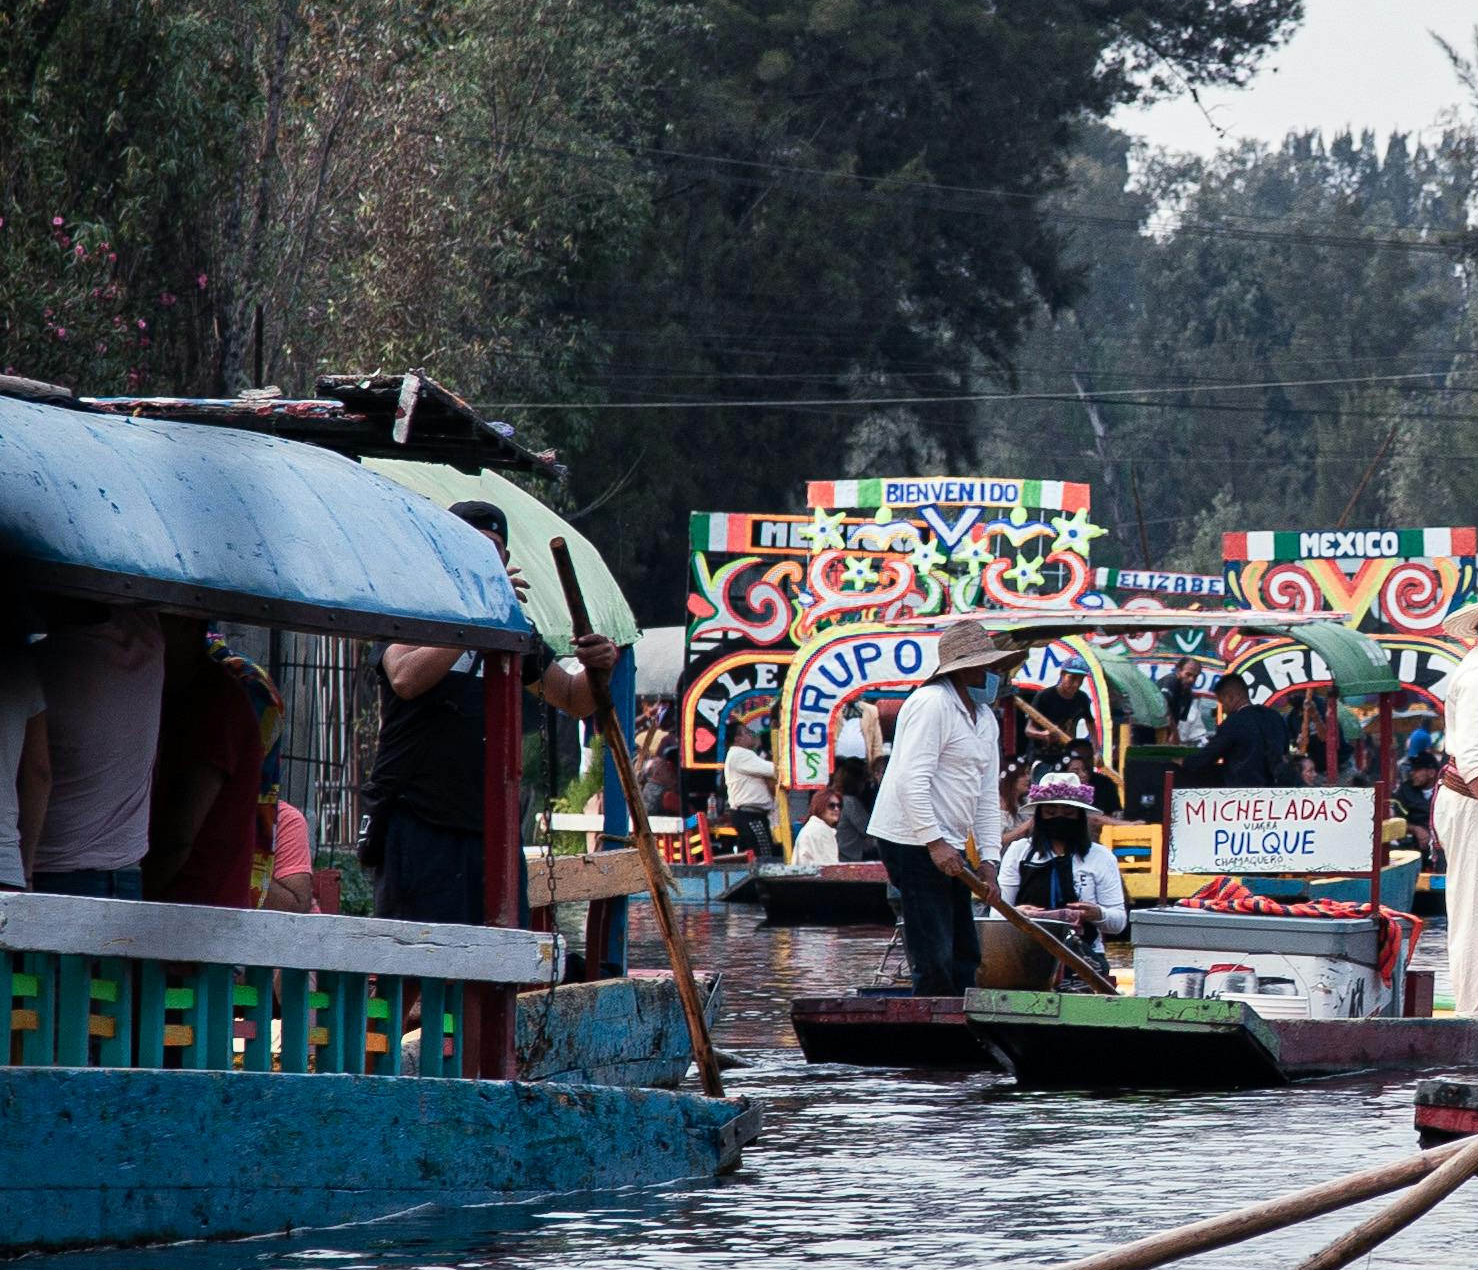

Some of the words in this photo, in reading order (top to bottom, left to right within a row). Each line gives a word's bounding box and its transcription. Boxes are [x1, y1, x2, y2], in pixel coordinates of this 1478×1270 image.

[886, 482, 1018, 503] BIENVENIDO
[1300, 531, 1398, 557] MEXICO
[796, 639, 922, 749] GRUPO
[1186, 798, 1353, 825] MICHELADAS
[1214, 829, 1316, 855] PULQUE
